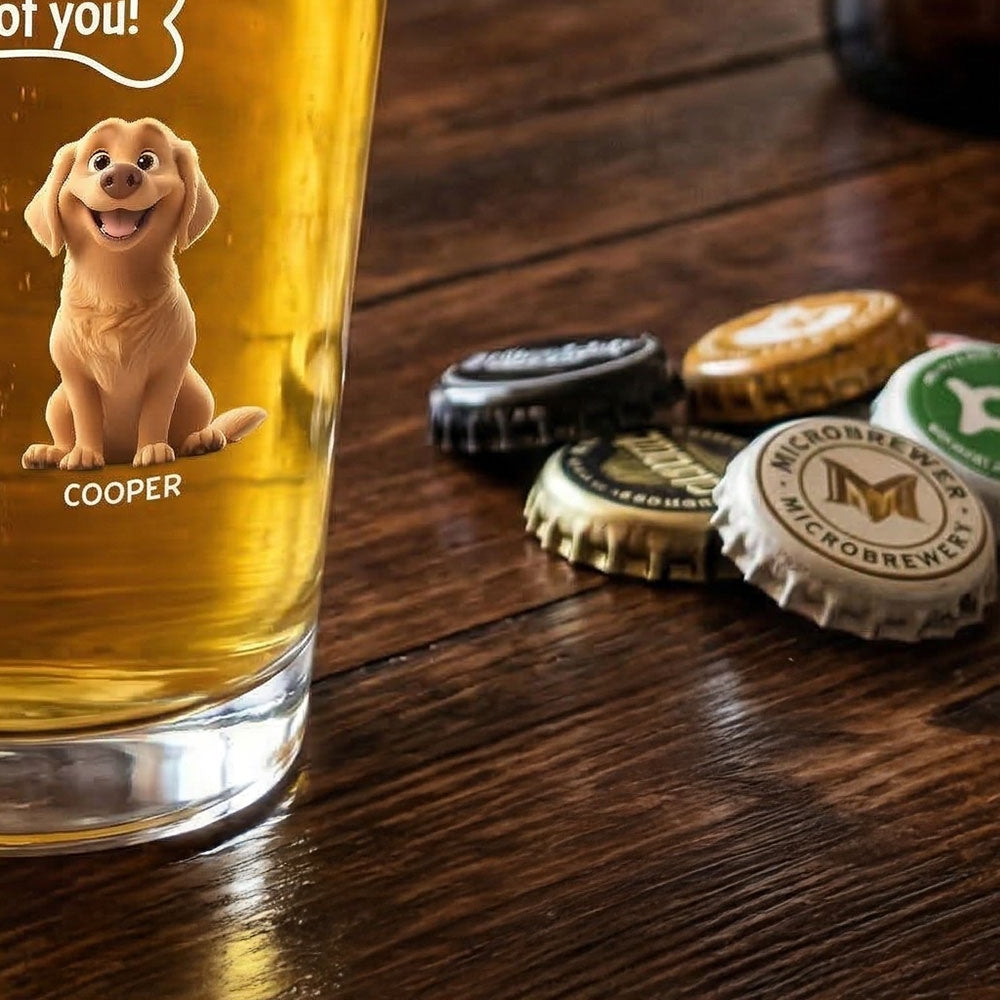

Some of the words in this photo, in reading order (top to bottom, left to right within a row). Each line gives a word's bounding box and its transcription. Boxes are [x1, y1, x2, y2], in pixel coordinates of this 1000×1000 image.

[63, 473, 182, 507] COOPER
[770, 424, 966, 500] MICROBREWER
[783, 496, 973, 569] MICROBREWERY
